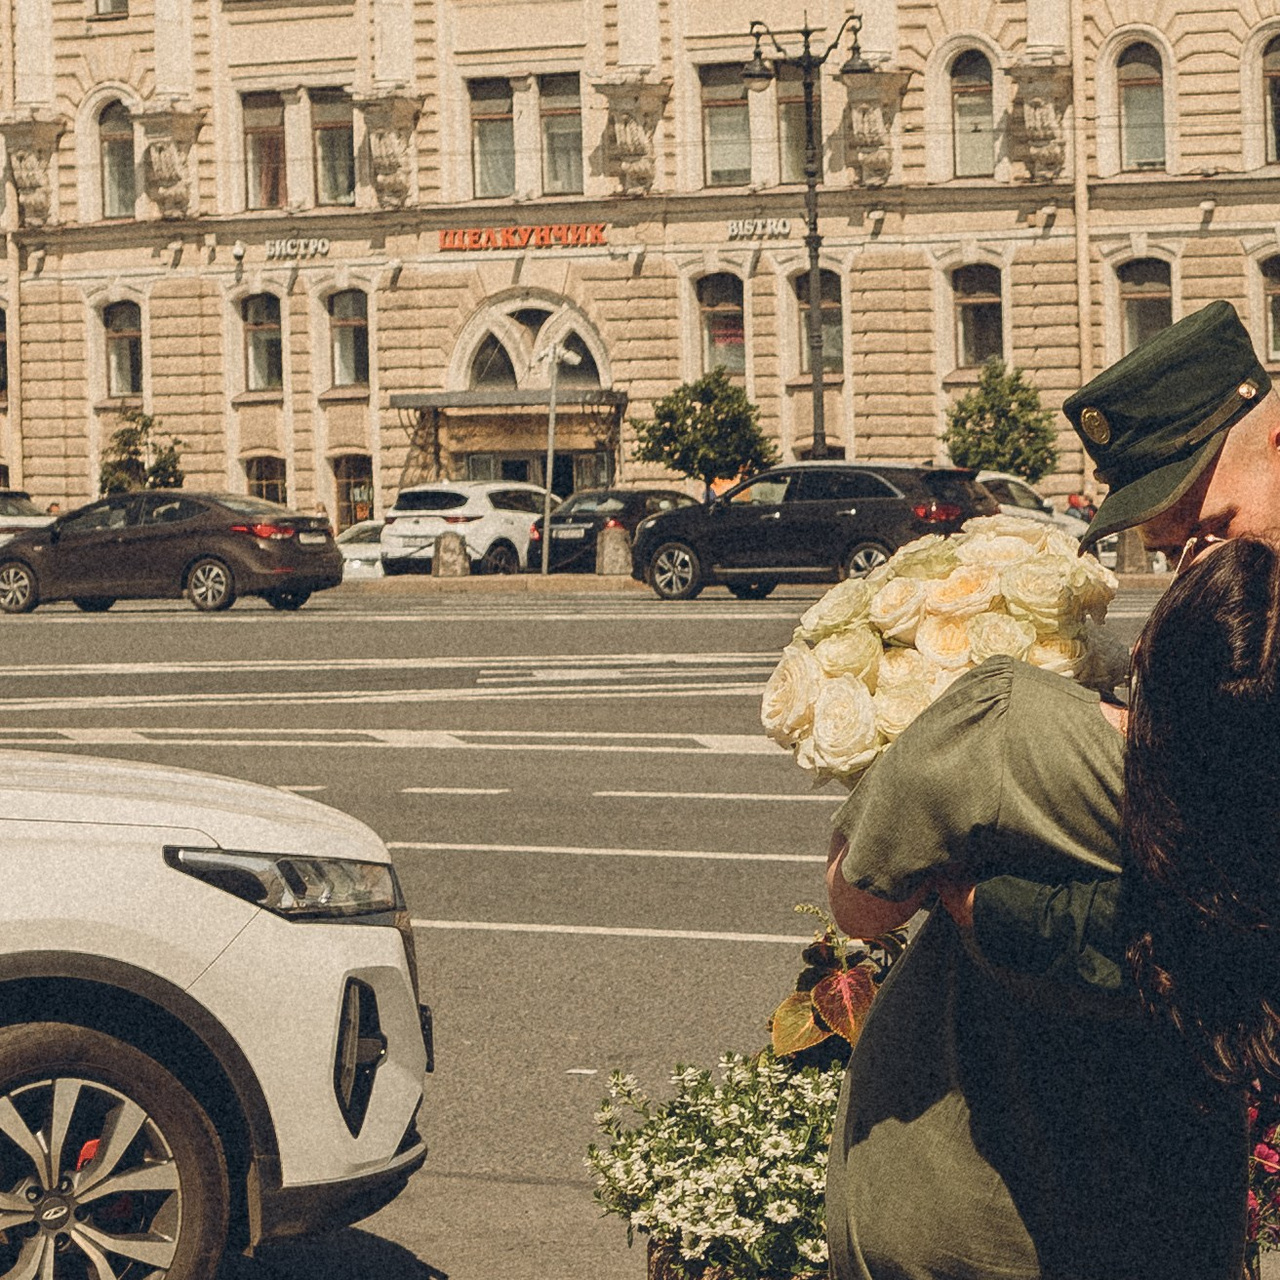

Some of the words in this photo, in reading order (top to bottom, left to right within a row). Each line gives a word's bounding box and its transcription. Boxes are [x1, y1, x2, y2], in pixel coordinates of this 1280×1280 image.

[438, 222, 607, 251] ЩЕЛКУНЧИК
[728, 218, 792, 237] BISTRO
[265, 237, 330, 257] БИСТРО
